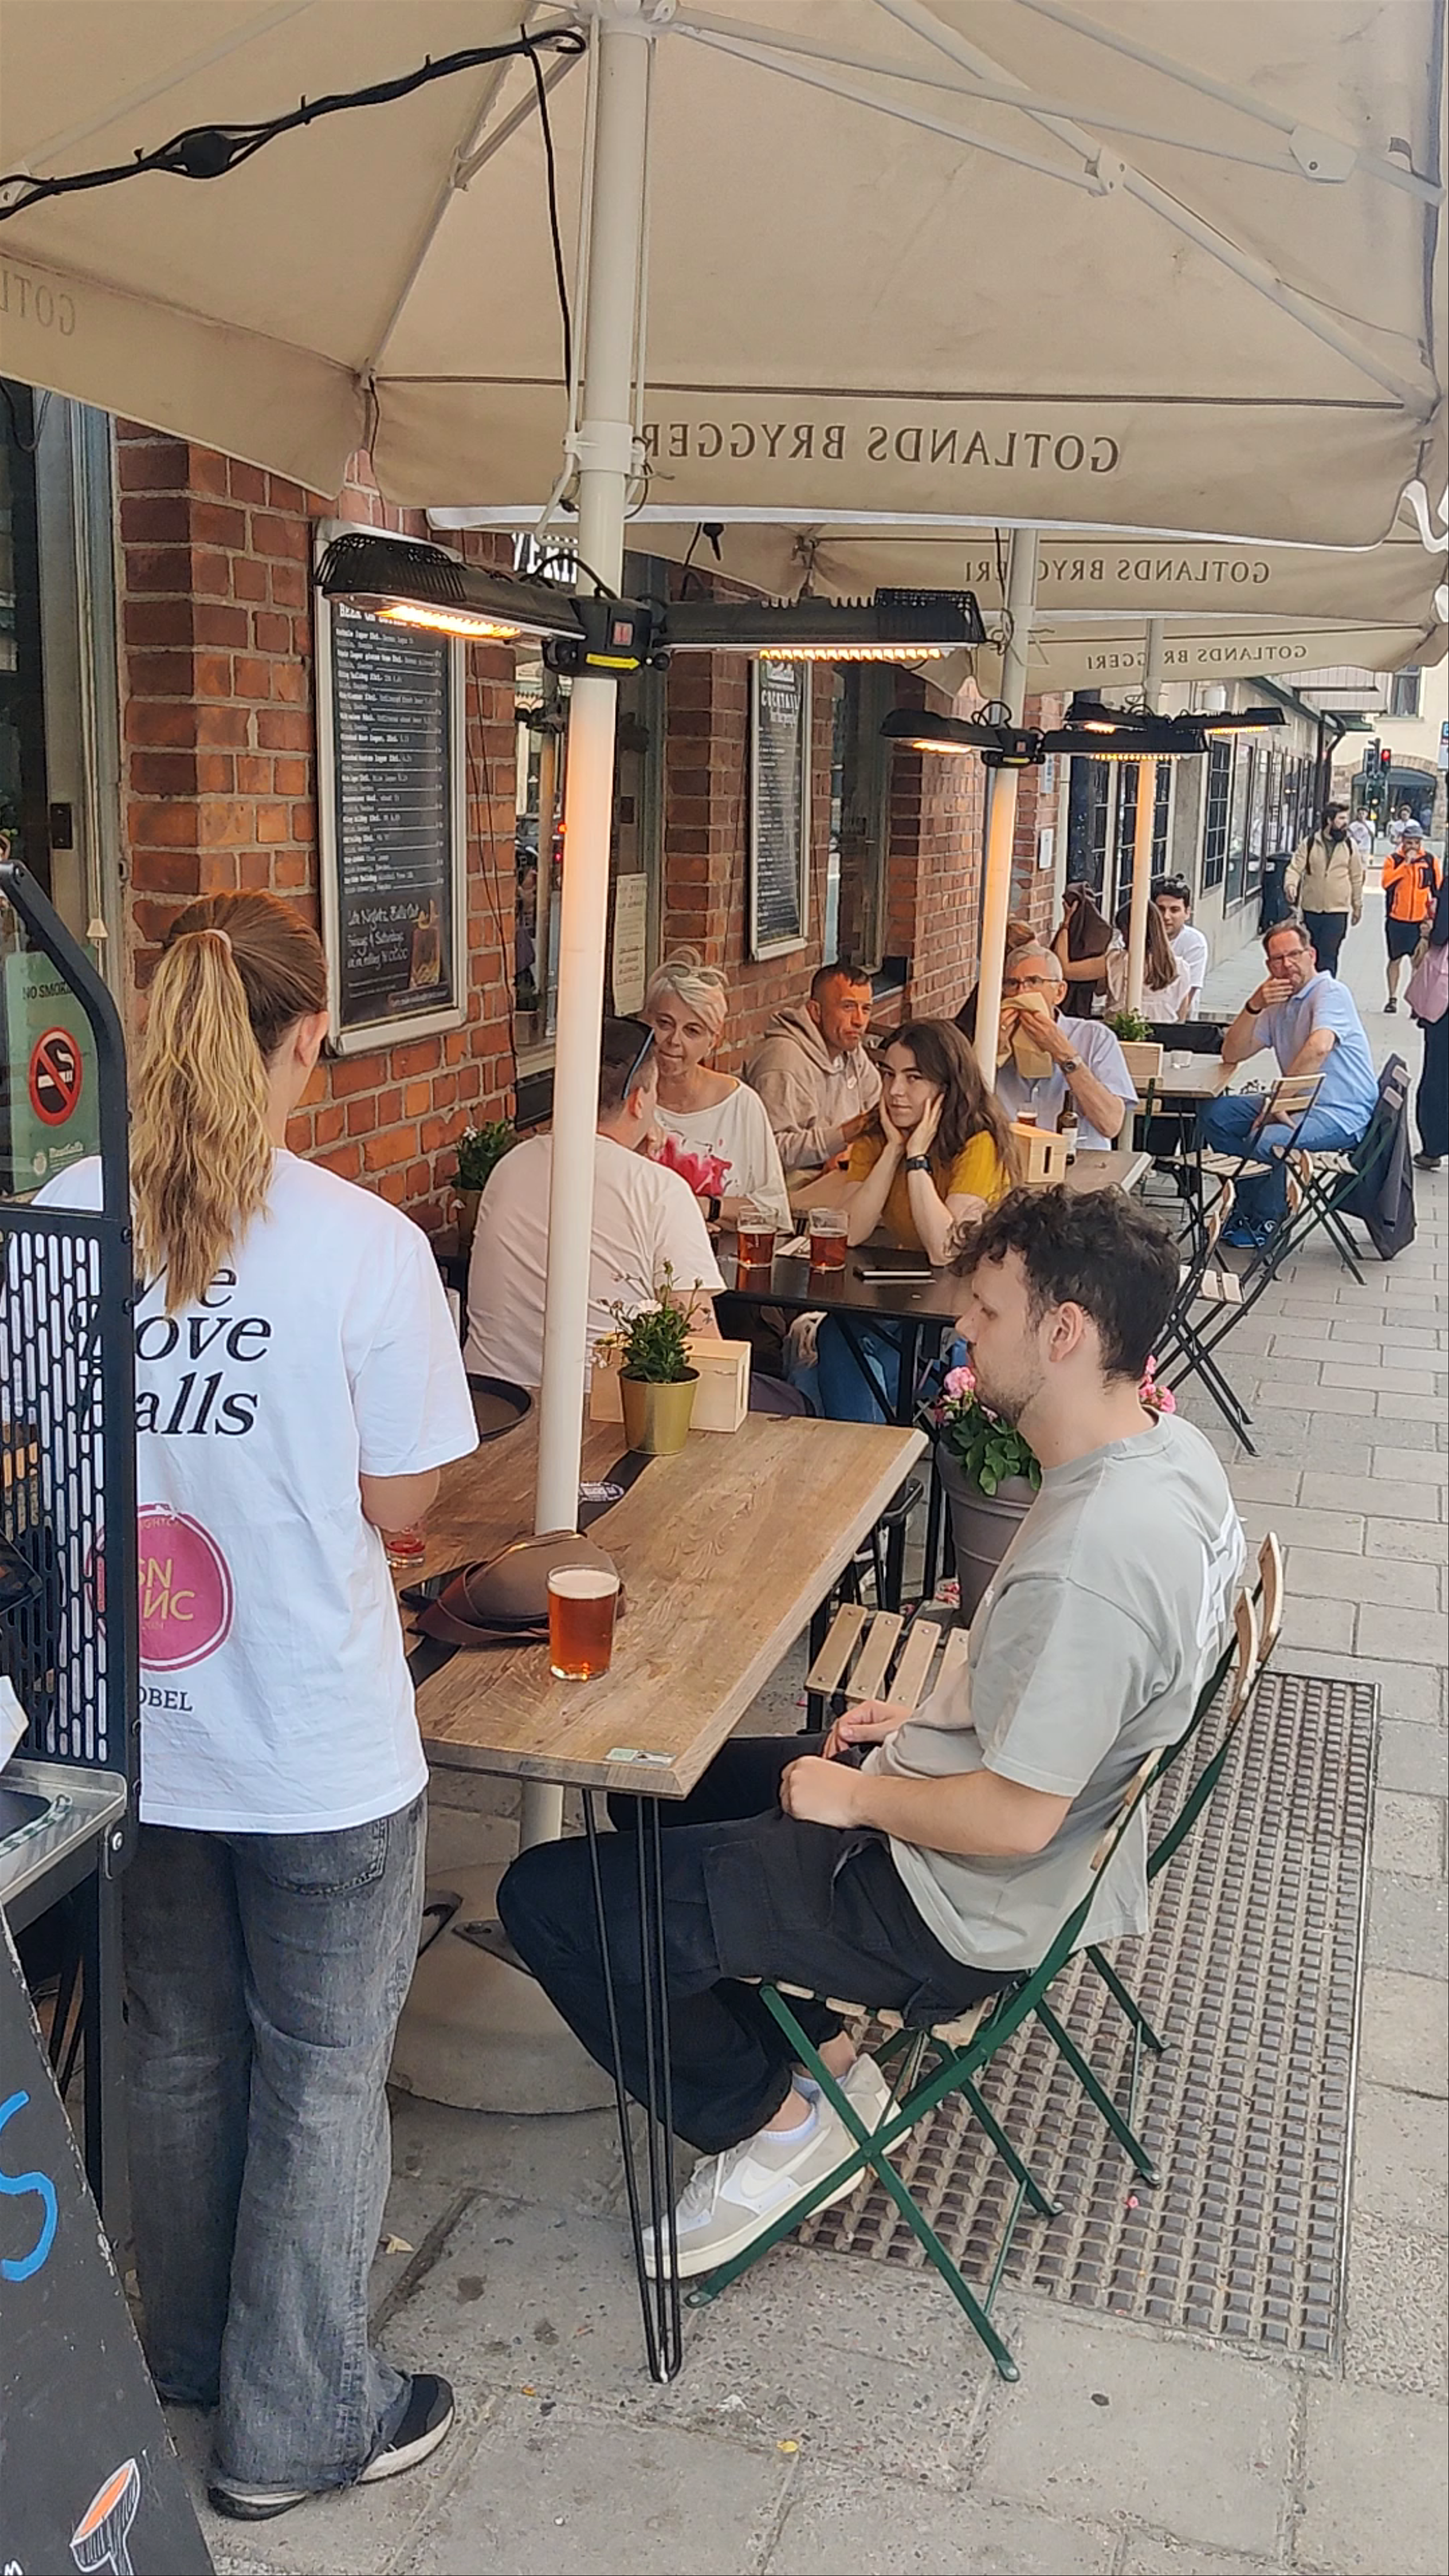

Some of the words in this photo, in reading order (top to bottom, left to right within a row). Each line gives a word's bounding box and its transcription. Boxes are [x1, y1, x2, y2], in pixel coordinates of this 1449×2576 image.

[22, 986, 37, 999] NO
[137, 1318, 271, 1361] ove
[137, 1372, 258, 1435] alls
